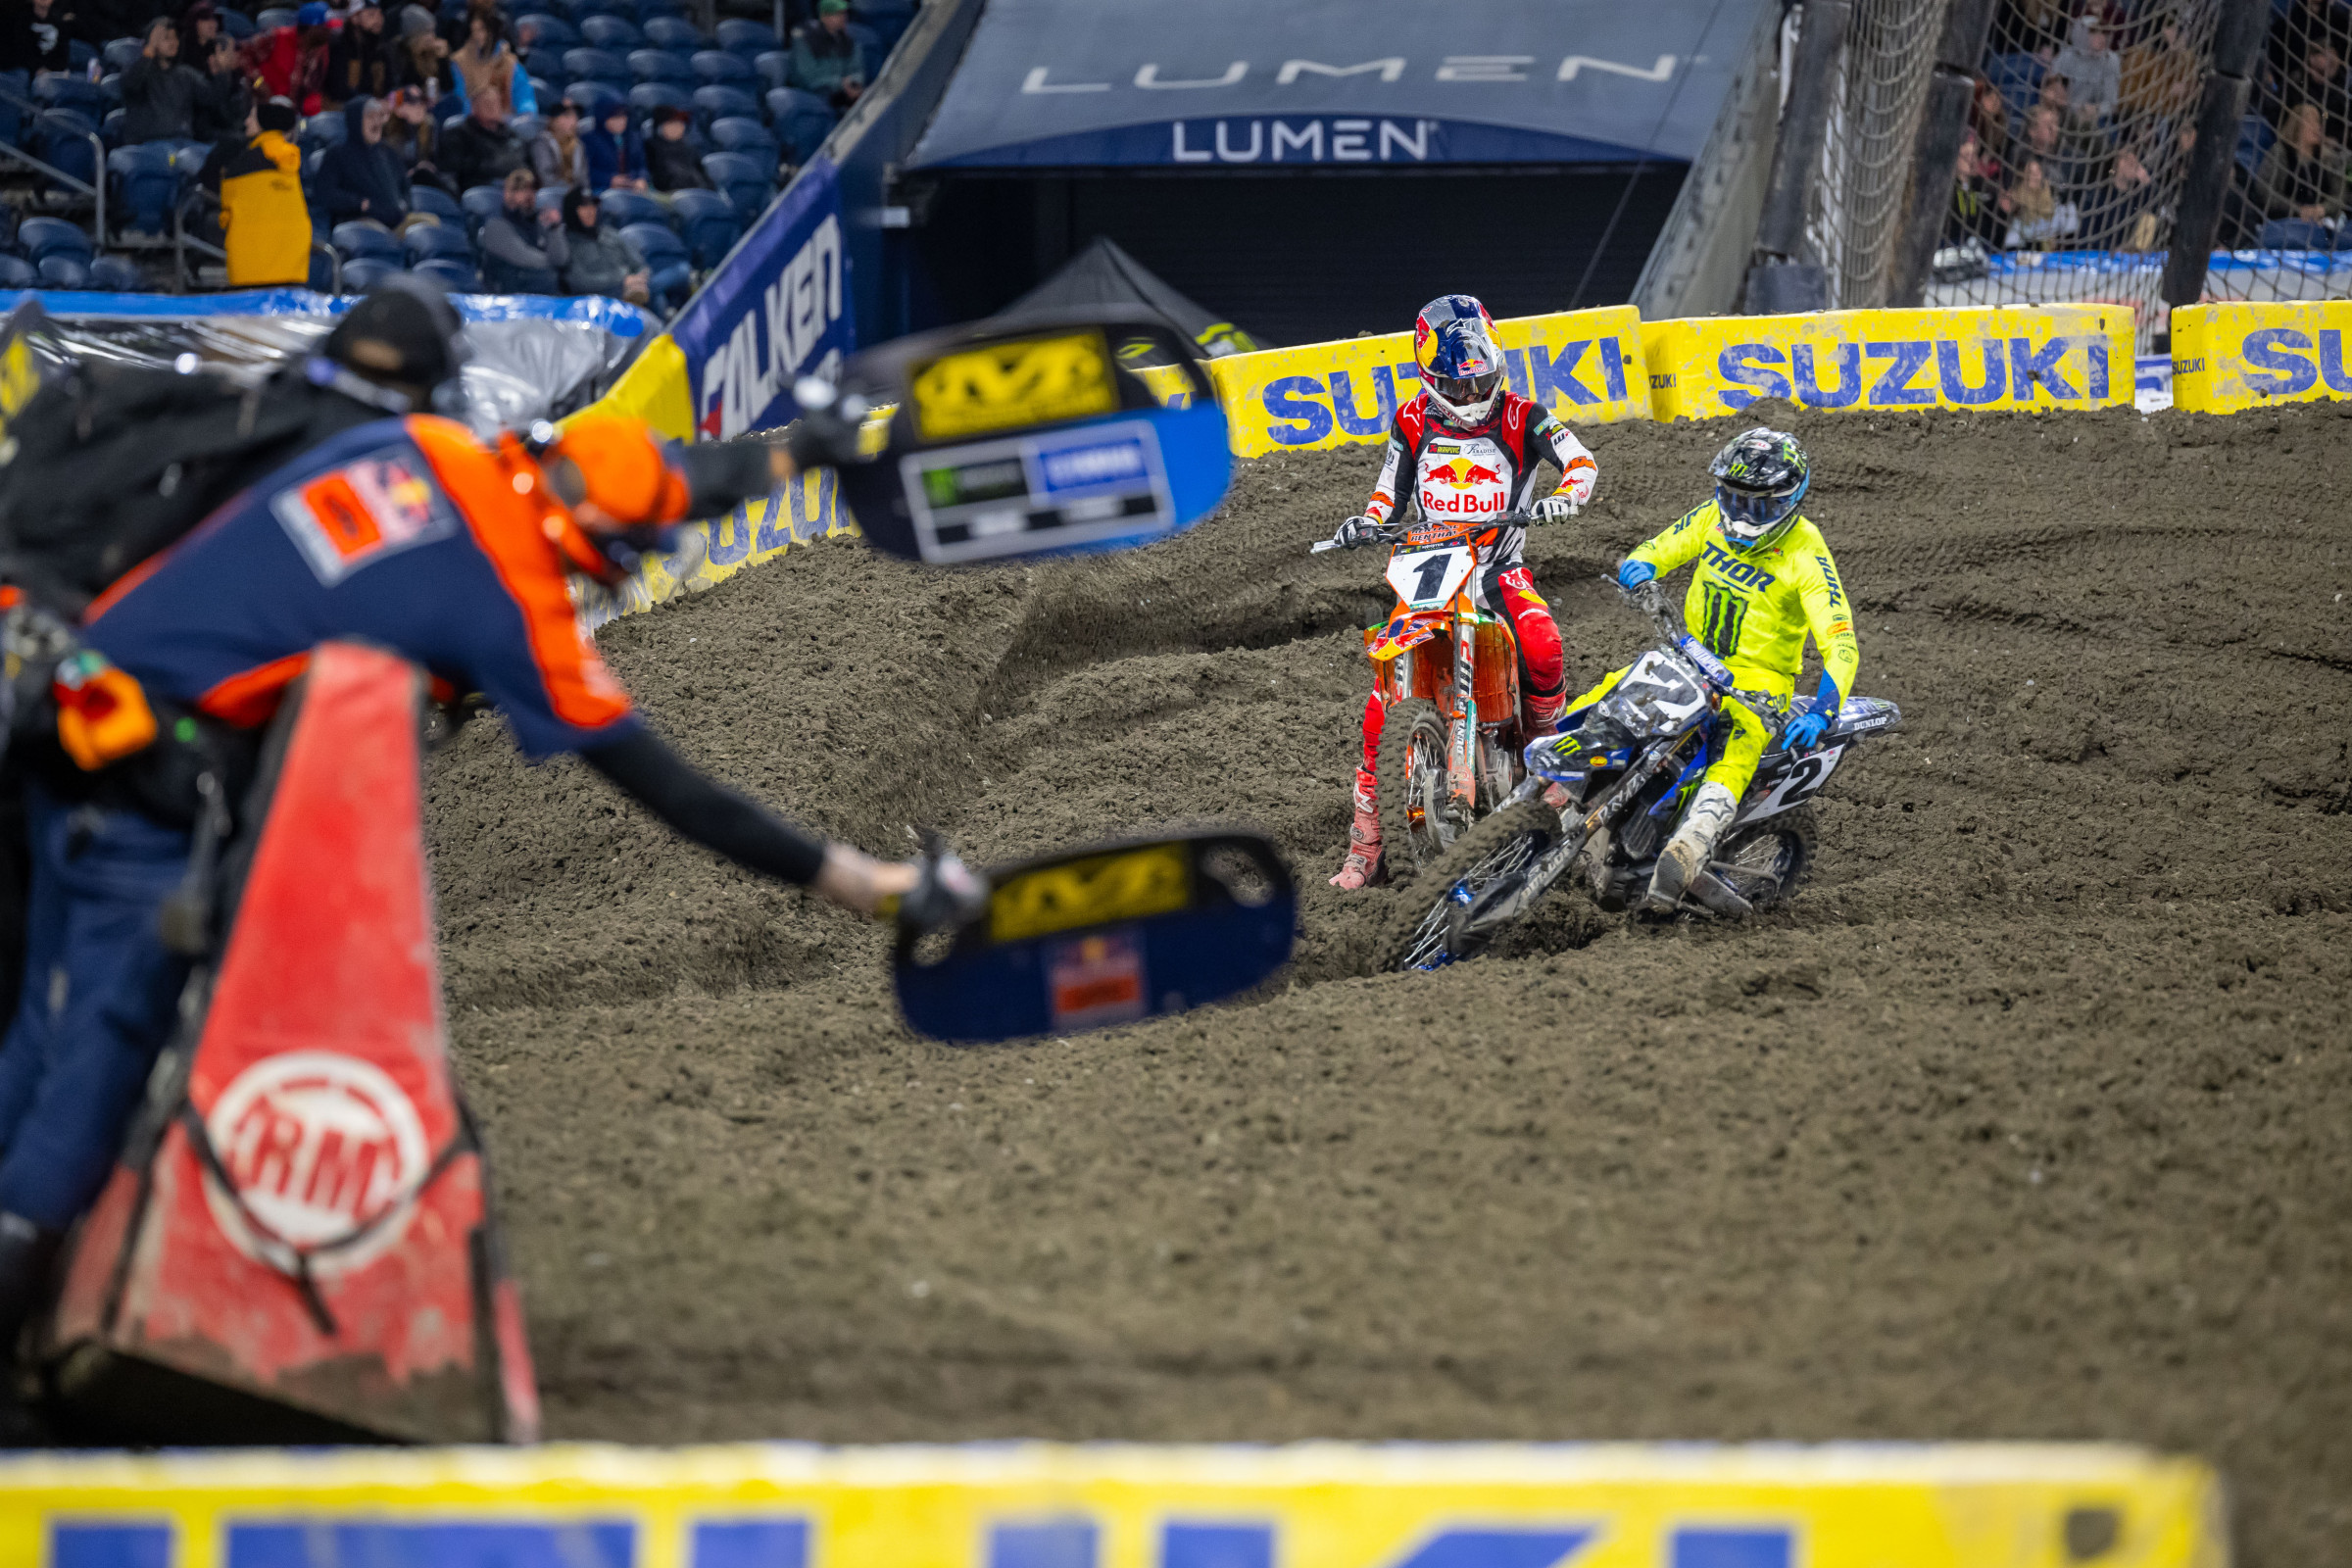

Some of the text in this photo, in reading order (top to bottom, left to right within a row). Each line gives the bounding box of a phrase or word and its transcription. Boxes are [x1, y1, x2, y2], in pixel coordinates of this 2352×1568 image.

[1020, 55, 1678, 94] LUMEN
[1173, 120, 1428, 163] LUMEN
[1648, 372, 1677, 390] ZUKI
[1717, 333, 2110, 410] SUZUKI
[2172, 357, 2205, 375] SUZUKI
[1423, 490, 1504, 513] Red Bull
[1412, 553, 1452, 602] 1
[1701, 540, 1776, 593] THOR
[1853, 716, 1887, 731] DUNLOP
[1778, 757, 1823, 808] 2
